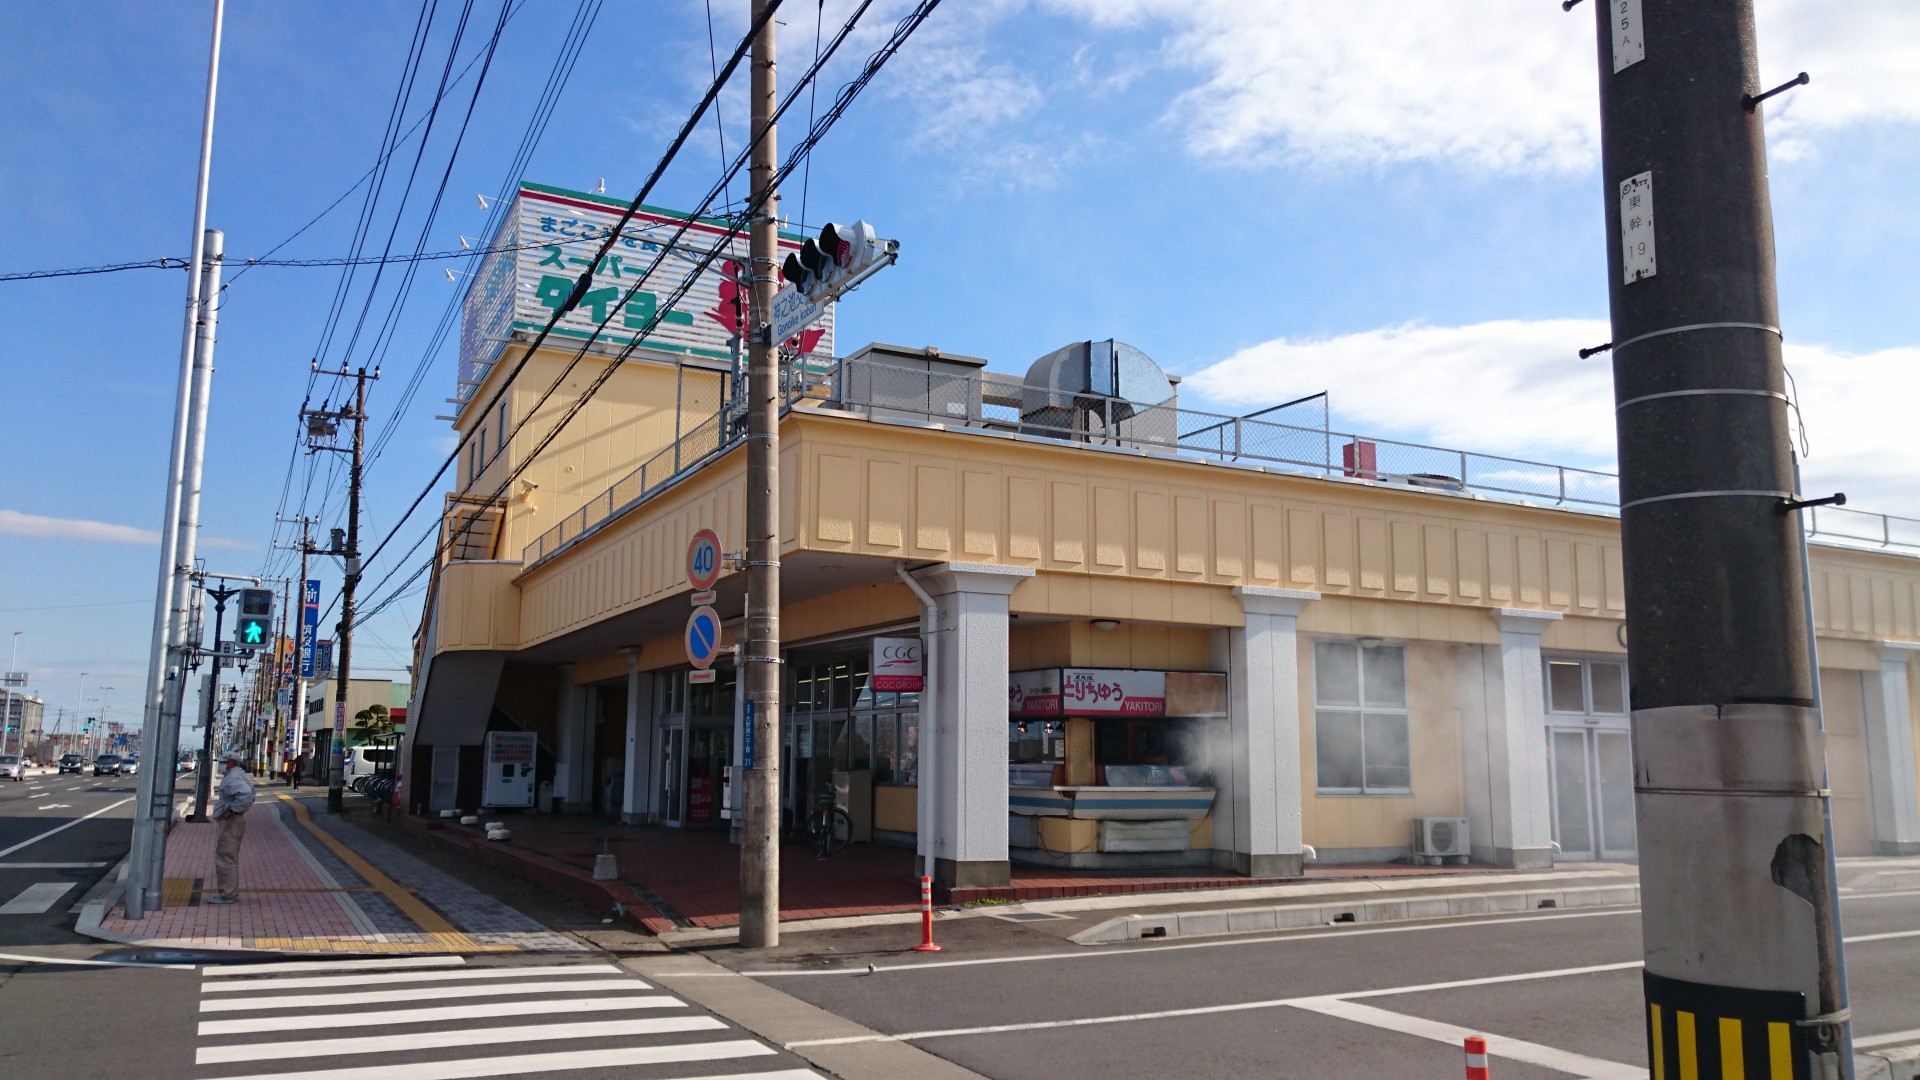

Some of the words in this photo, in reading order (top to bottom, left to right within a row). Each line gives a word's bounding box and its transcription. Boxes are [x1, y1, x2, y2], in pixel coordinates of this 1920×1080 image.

[1629, 242, 1646, 258] 19
[538, 246, 658, 279] スーパー
[535, 275, 694, 333] タイヨー
[778, 315, 798, 336] Gonoike
[694, 545, 712, 573] 40
[883, 645, 918, 660] CGC
[876, 681, 895, 689] CGC
[895, 681, 921, 689] GROUP
[1026, 699, 1058, 711] YAKITORI
[1125, 700, 1163, 711] YAKITORI
